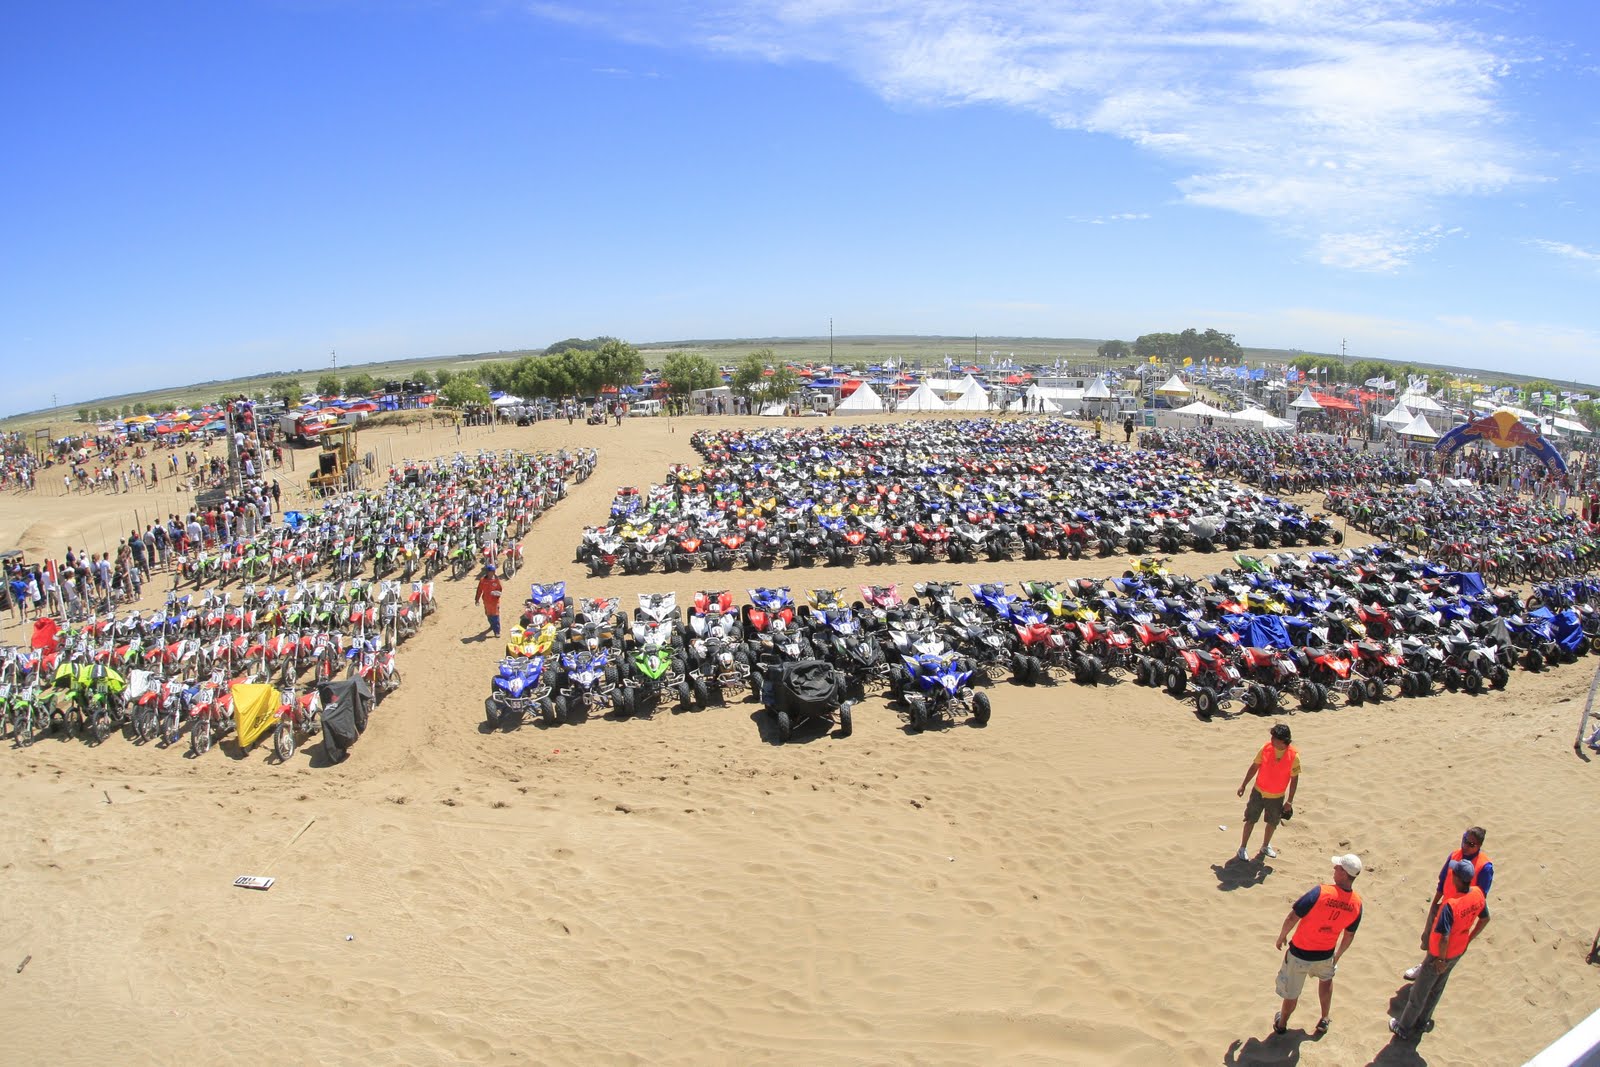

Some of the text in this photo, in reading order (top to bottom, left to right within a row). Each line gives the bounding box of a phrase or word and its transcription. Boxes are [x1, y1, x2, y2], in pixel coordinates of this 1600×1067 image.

[1325, 896, 1355, 912] SEGURIDAD
[1459, 902, 1484, 918] SEGURI
[1328, 910, 1341, 920] 10
